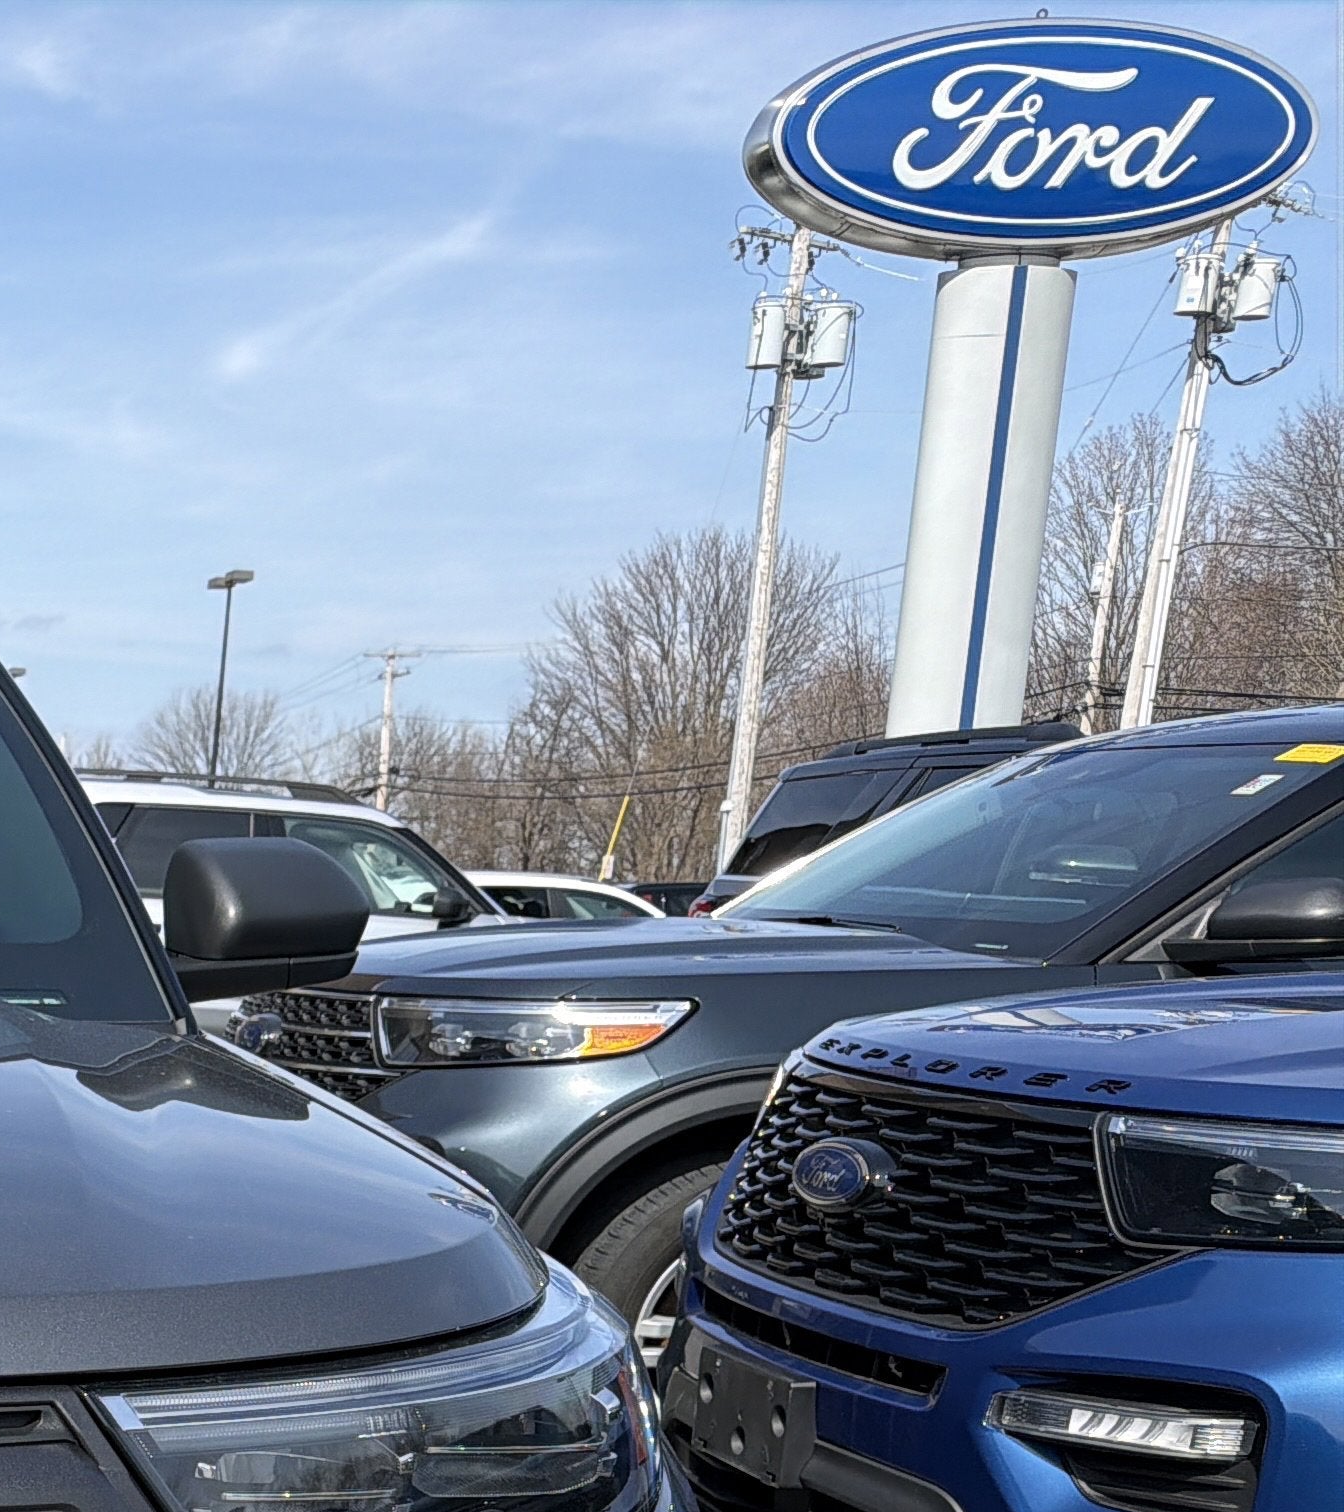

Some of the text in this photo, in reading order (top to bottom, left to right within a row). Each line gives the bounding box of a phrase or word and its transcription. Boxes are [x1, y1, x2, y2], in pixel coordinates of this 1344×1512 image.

[892, 63, 1216, 192] Ford
[818, 1038, 1133, 1095] EXPLORER
[801, 1152, 847, 1192] Ford
